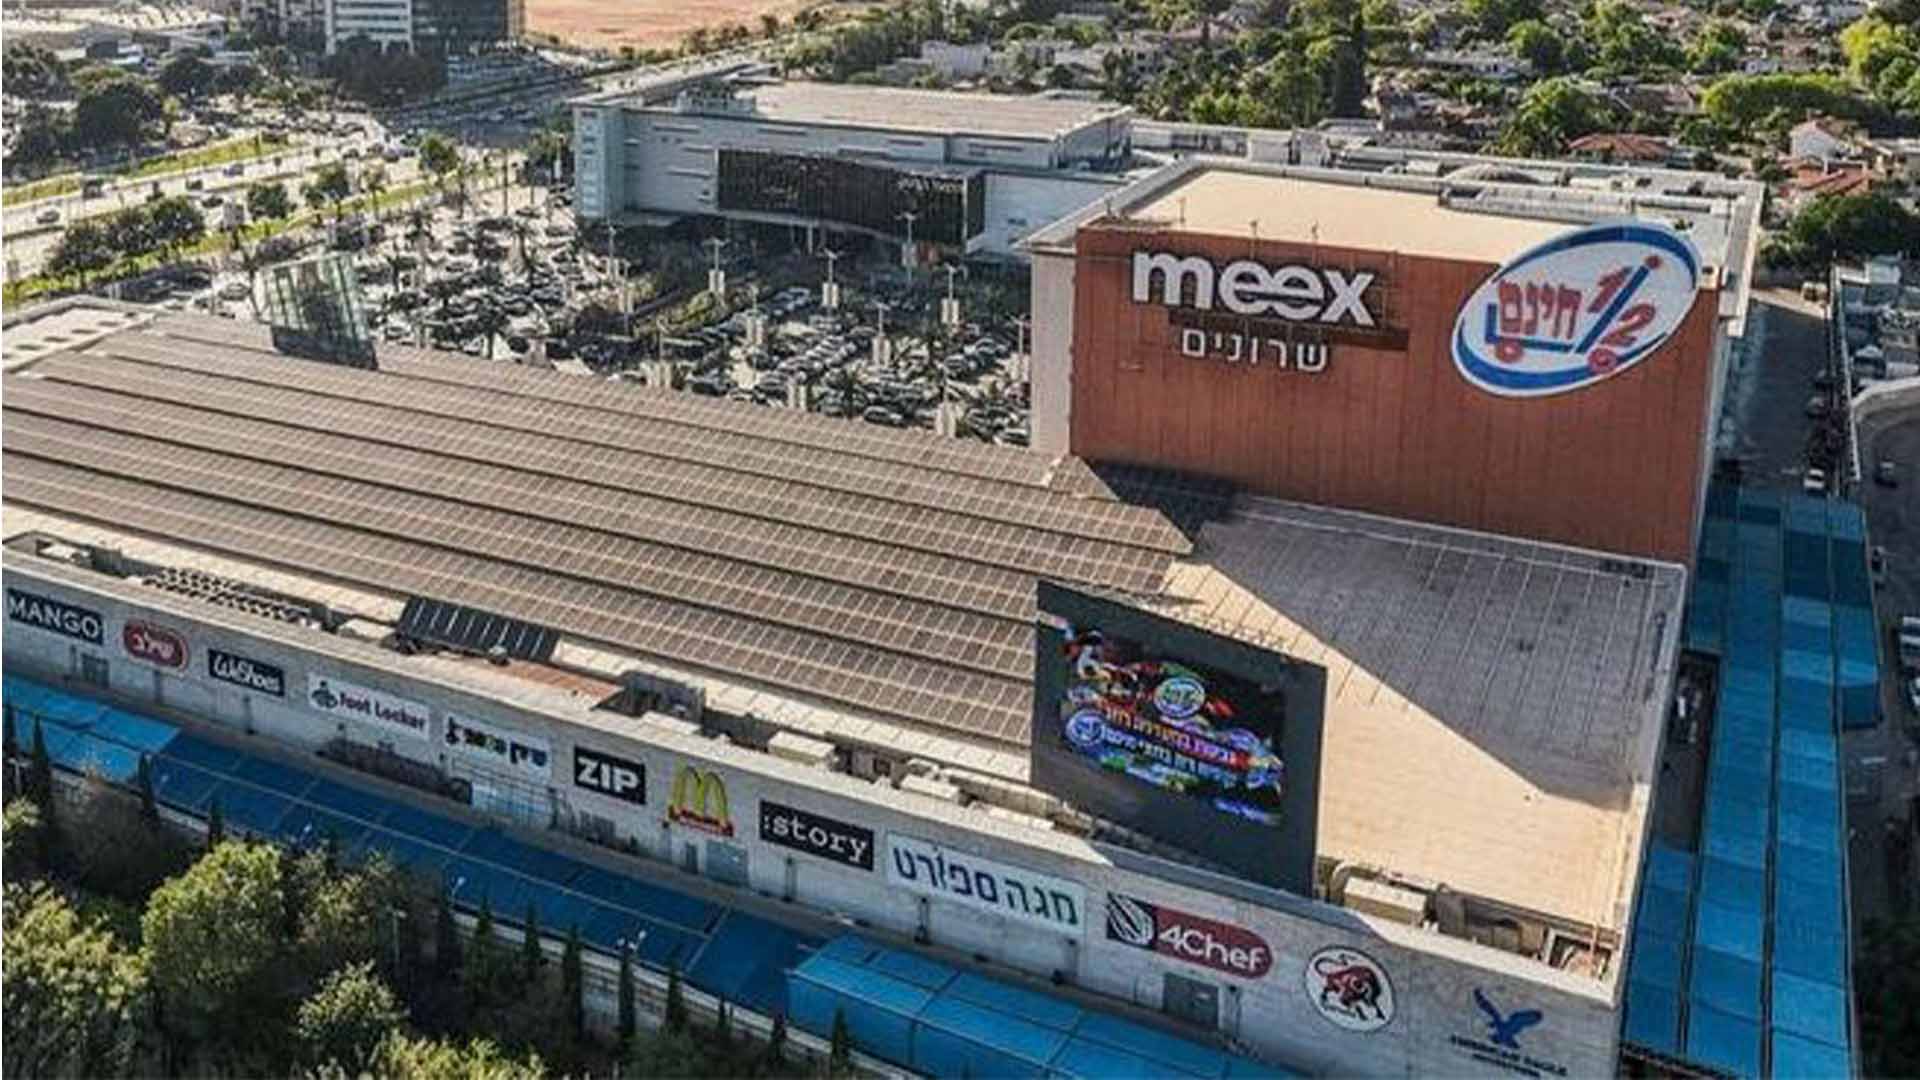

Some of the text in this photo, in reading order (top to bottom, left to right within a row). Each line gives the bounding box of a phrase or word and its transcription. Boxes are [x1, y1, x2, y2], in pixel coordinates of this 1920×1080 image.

[1133, 247, 1376, 327] meex
[1499, 279, 1583, 340] חינם
[1182, 325, 1329, 373] שרונים
[8, 594, 101, 641] MANGO
[577, 754, 640, 794] ZIP
[893, 842, 1080, 927] מגה ספורט
[1158, 927, 1266, 973] 4Chef
